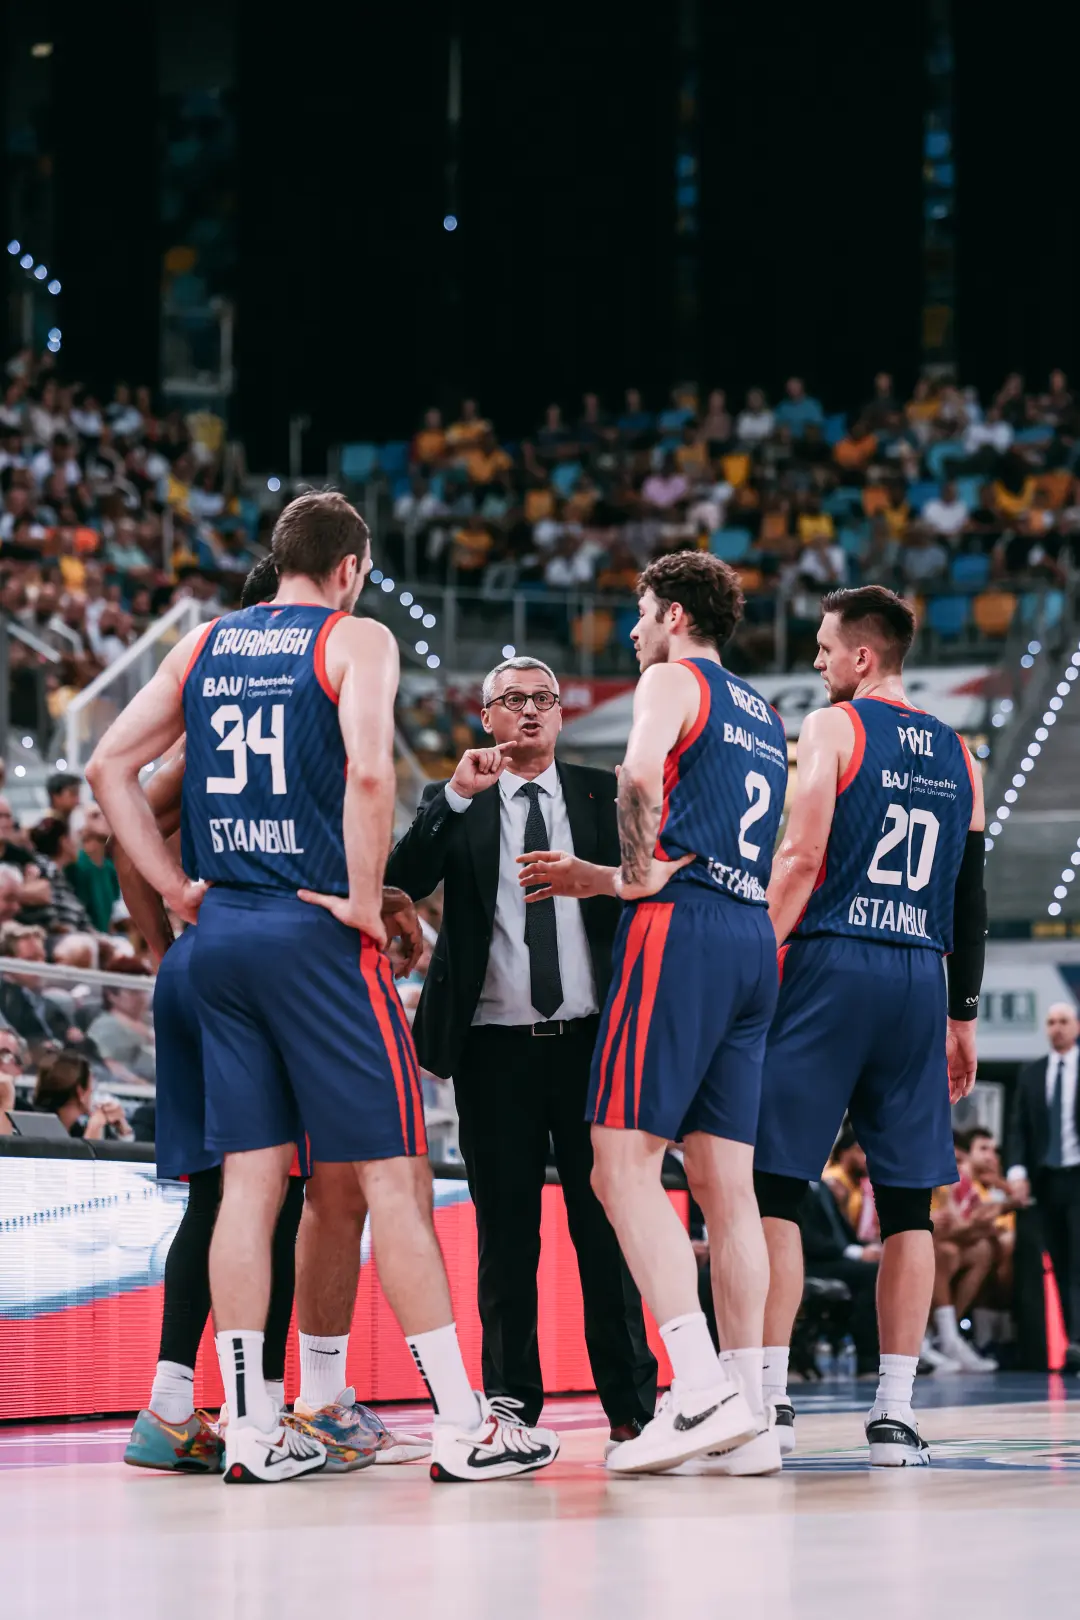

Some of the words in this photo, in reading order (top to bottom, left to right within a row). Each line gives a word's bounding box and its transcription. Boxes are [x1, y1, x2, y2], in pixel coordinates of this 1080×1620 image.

[212, 628, 313, 656] CAVANAUGH
[203, 676, 243, 697] BAU
[726, 680, 772, 726] HAZER
[206, 704, 287, 795] 34
[724, 722, 752, 752] BAU
[882, 769, 909, 790] BAU
[912, 774, 958, 790] ahçeşehir
[927, 787, 957, 801] University
[738, 770, 771, 862] 2
[209, 818, 304, 854] STANBUL
[867, 803, 940, 892] 20
[848, 892, 932, 940] İSTANBUL
